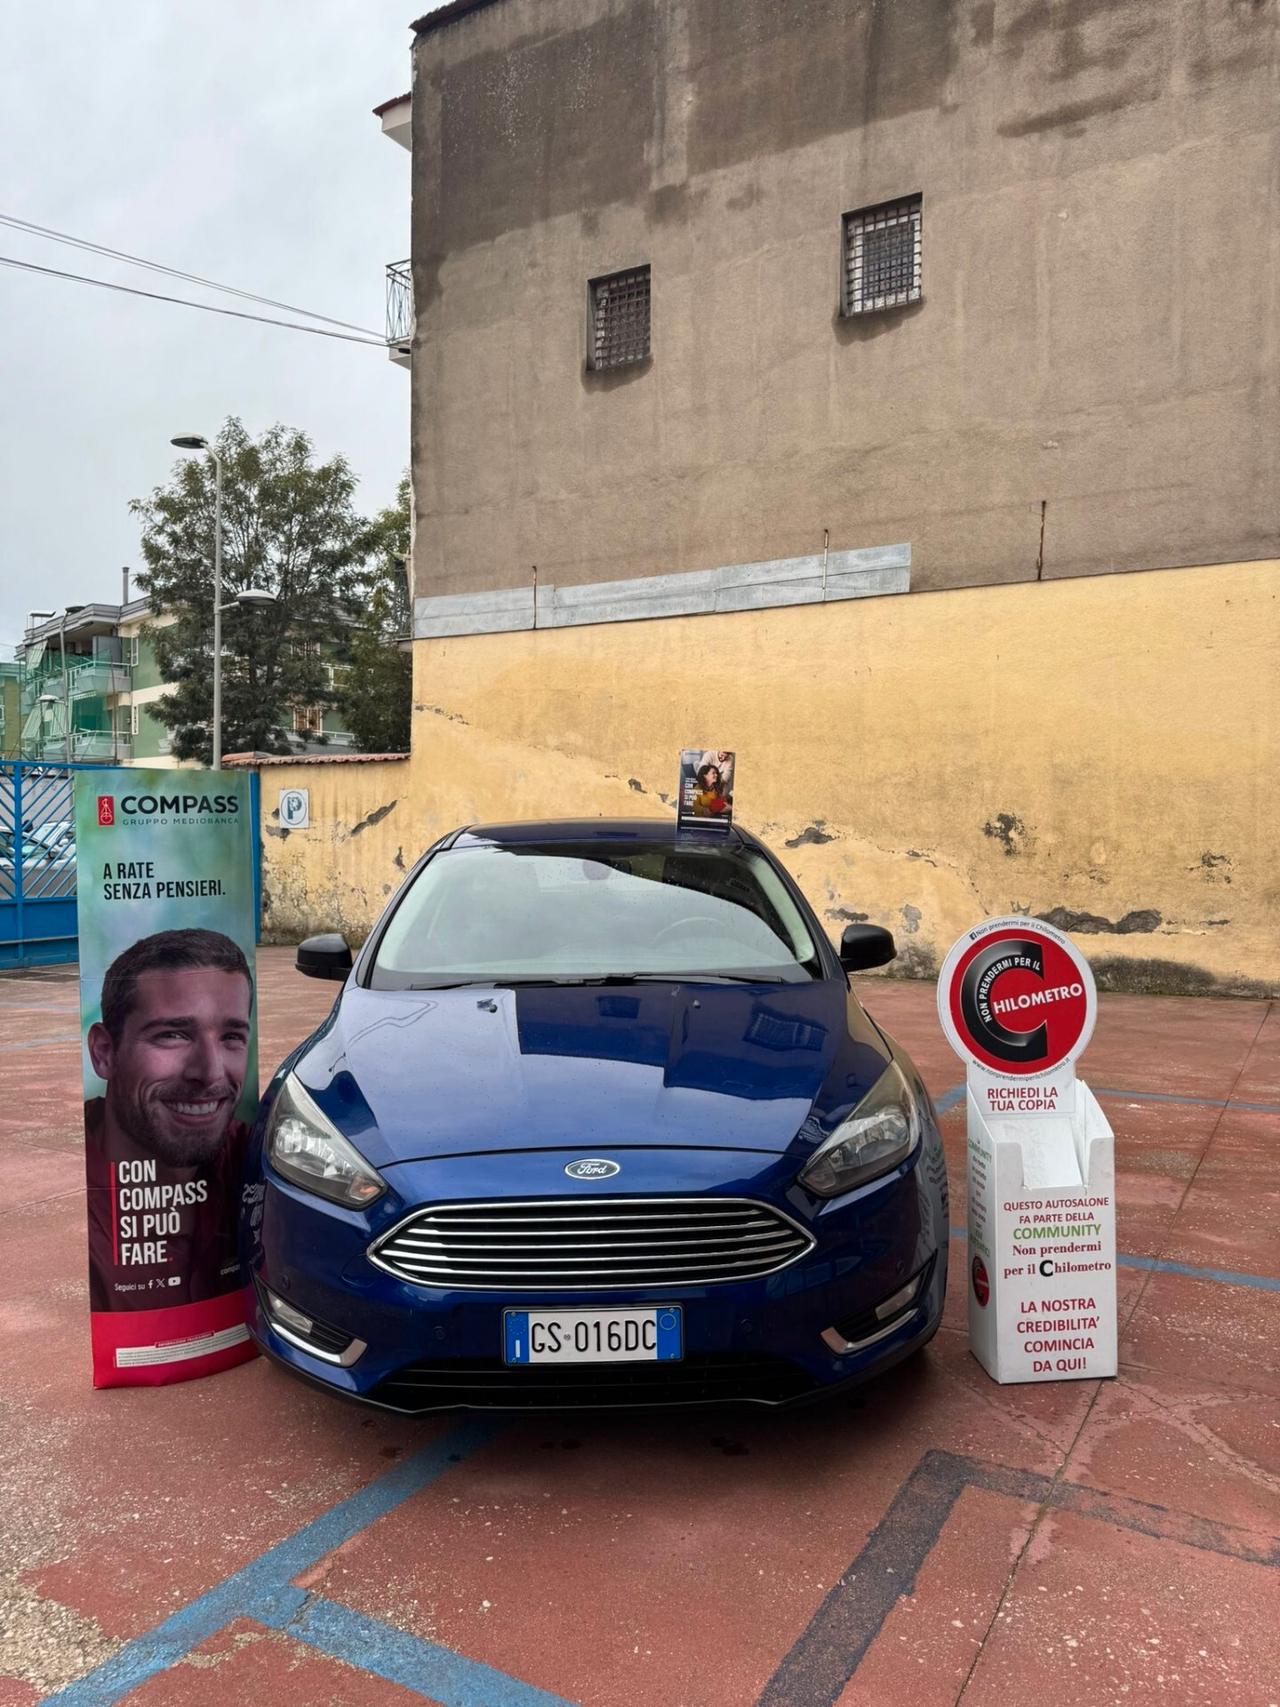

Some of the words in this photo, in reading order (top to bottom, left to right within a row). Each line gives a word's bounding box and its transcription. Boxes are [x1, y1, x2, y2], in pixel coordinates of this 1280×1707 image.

[121, 795, 239, 814] COMPASS
[122, 818, 168, 826] GRUPPO
[173, 817, 239, 825] MEDIOBANCA
[103, 863, 112, 879] A
[118, 862, 154, 879] RATE
[104, 883, 151, 900] SENZA
[156, 880, 226, 898] PENSIERI.
[976, 927, 988, 936] Non
[989, 919, 1019, 931] prendermi
[1036, 923, 1066, 945] Chilometro
[1014, 957, 1030, 967] PER
[1032, 960, 1040, 970] IL
[979, 958, 1012, 1000] PRENDERMI
[981, 1001, 992, 1023] NON
[987, 1088, 1040, 1100] RICHIEDI
[1043, 1086, 1058, 1098] LA
[990, 1100, 1016, 1112] TUA
[1018, 1099, 1056, 1110] COPIA
[118, 1159, 156, 1184] CON
[577, 1162, 607, 1175] Ford
[119, 1180, 208, 1211] COMPASS
[1003, 1200, 1043, 1212] QUESTO
[1045, 1197, 1109, 1210] AUTOSALONE
[120, 1216, 137, 1239] SI
[143, 1207, 180, 1238] PUÒ
[1019, 1215, 1030, 1224] FA
[1034, 1214, 1062, 1224] PARTE
[1066, 1212, 1094, 1222] DELLA
[1013, 1224, 1101, 1240] COMMUNITY
[1012, 1244, 1036, 1256] Non
[1040, 1241, 1101, 1257] prendermi
[1004, 1266, 1024, 1280] per
[1026, 1263, 1036, 1276] il
[1039, 1259, 1111, 1277] Chilometro
[114, 1283, 136, 1293] Seguici
[1020, 1302, 1037, 1314] LA
[1041, 1298, 1096, 1312] NOSTRA
[531, 1322, 562, 1353] GS
[574, 1320, 657, 1352] 016DC
[1024, 1338, 1094, 1354] COMINCIA
[1032, 1360, 1052, 1372] DA
[1056, 1357, 1086, 1372] QUI!
